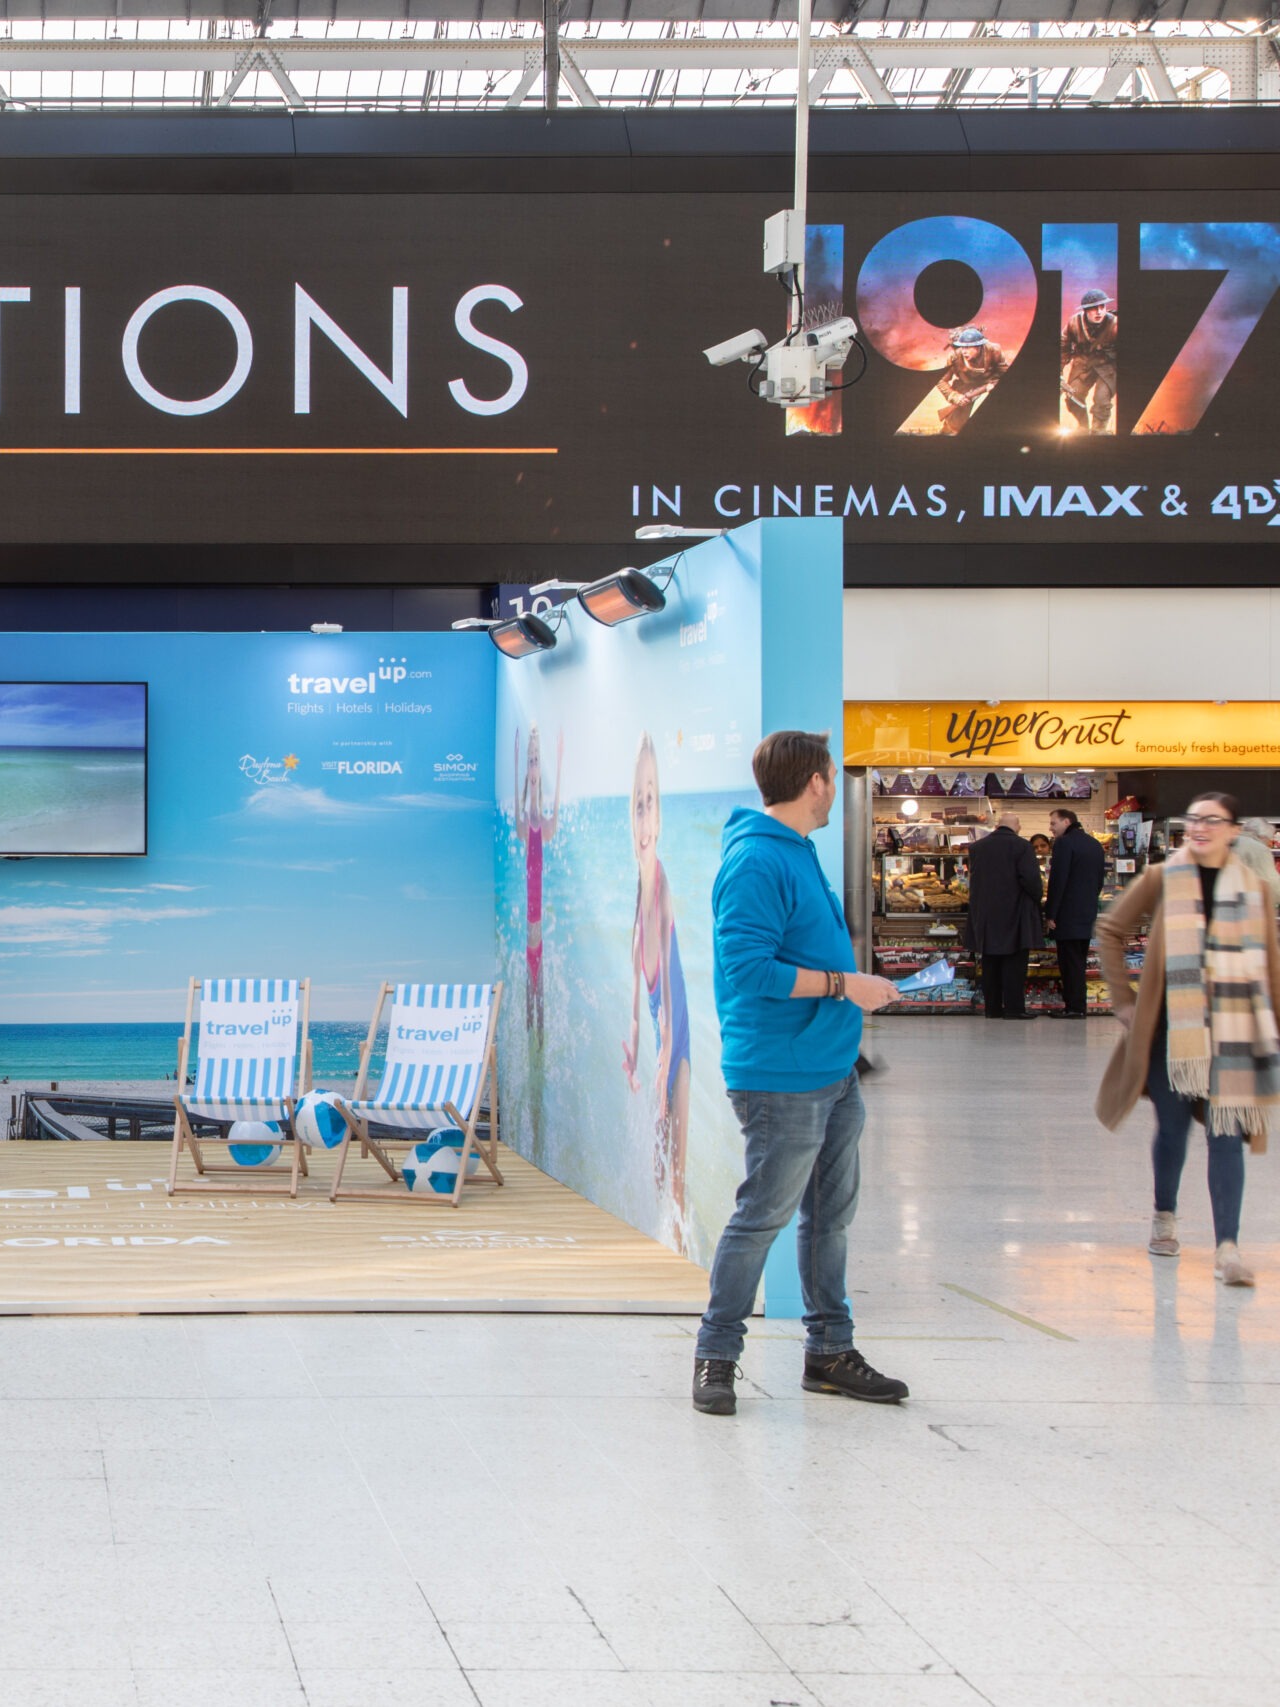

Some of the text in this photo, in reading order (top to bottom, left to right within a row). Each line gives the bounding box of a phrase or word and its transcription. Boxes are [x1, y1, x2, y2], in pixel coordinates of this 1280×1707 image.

[785, 215, 1280, 436] 1917
[632, 485, 682, 516] IN
[714, 484, 966, 523] CINEMAS,
[983, 485, 1145, 517] IMAX
[1161, 485, 1189, 516] &
[679, 614, 707, 647] travel
[287, 672, 376, 694] travel
[287, 702, 433, 716] Flights Hotels Holidays
[946, 709, 1131, 759] Upper Crust
[1135, 741, 1280, 756] famously fresh baguettes
[338, 760, 403, 774] FLORIDA
[433, 763, 477, 772] SIMON
[206, 1012, 291, 1036] travel up
[396, 1018, 482, 1042] travel up
[138, 1200, 337, 1210] Holidays
